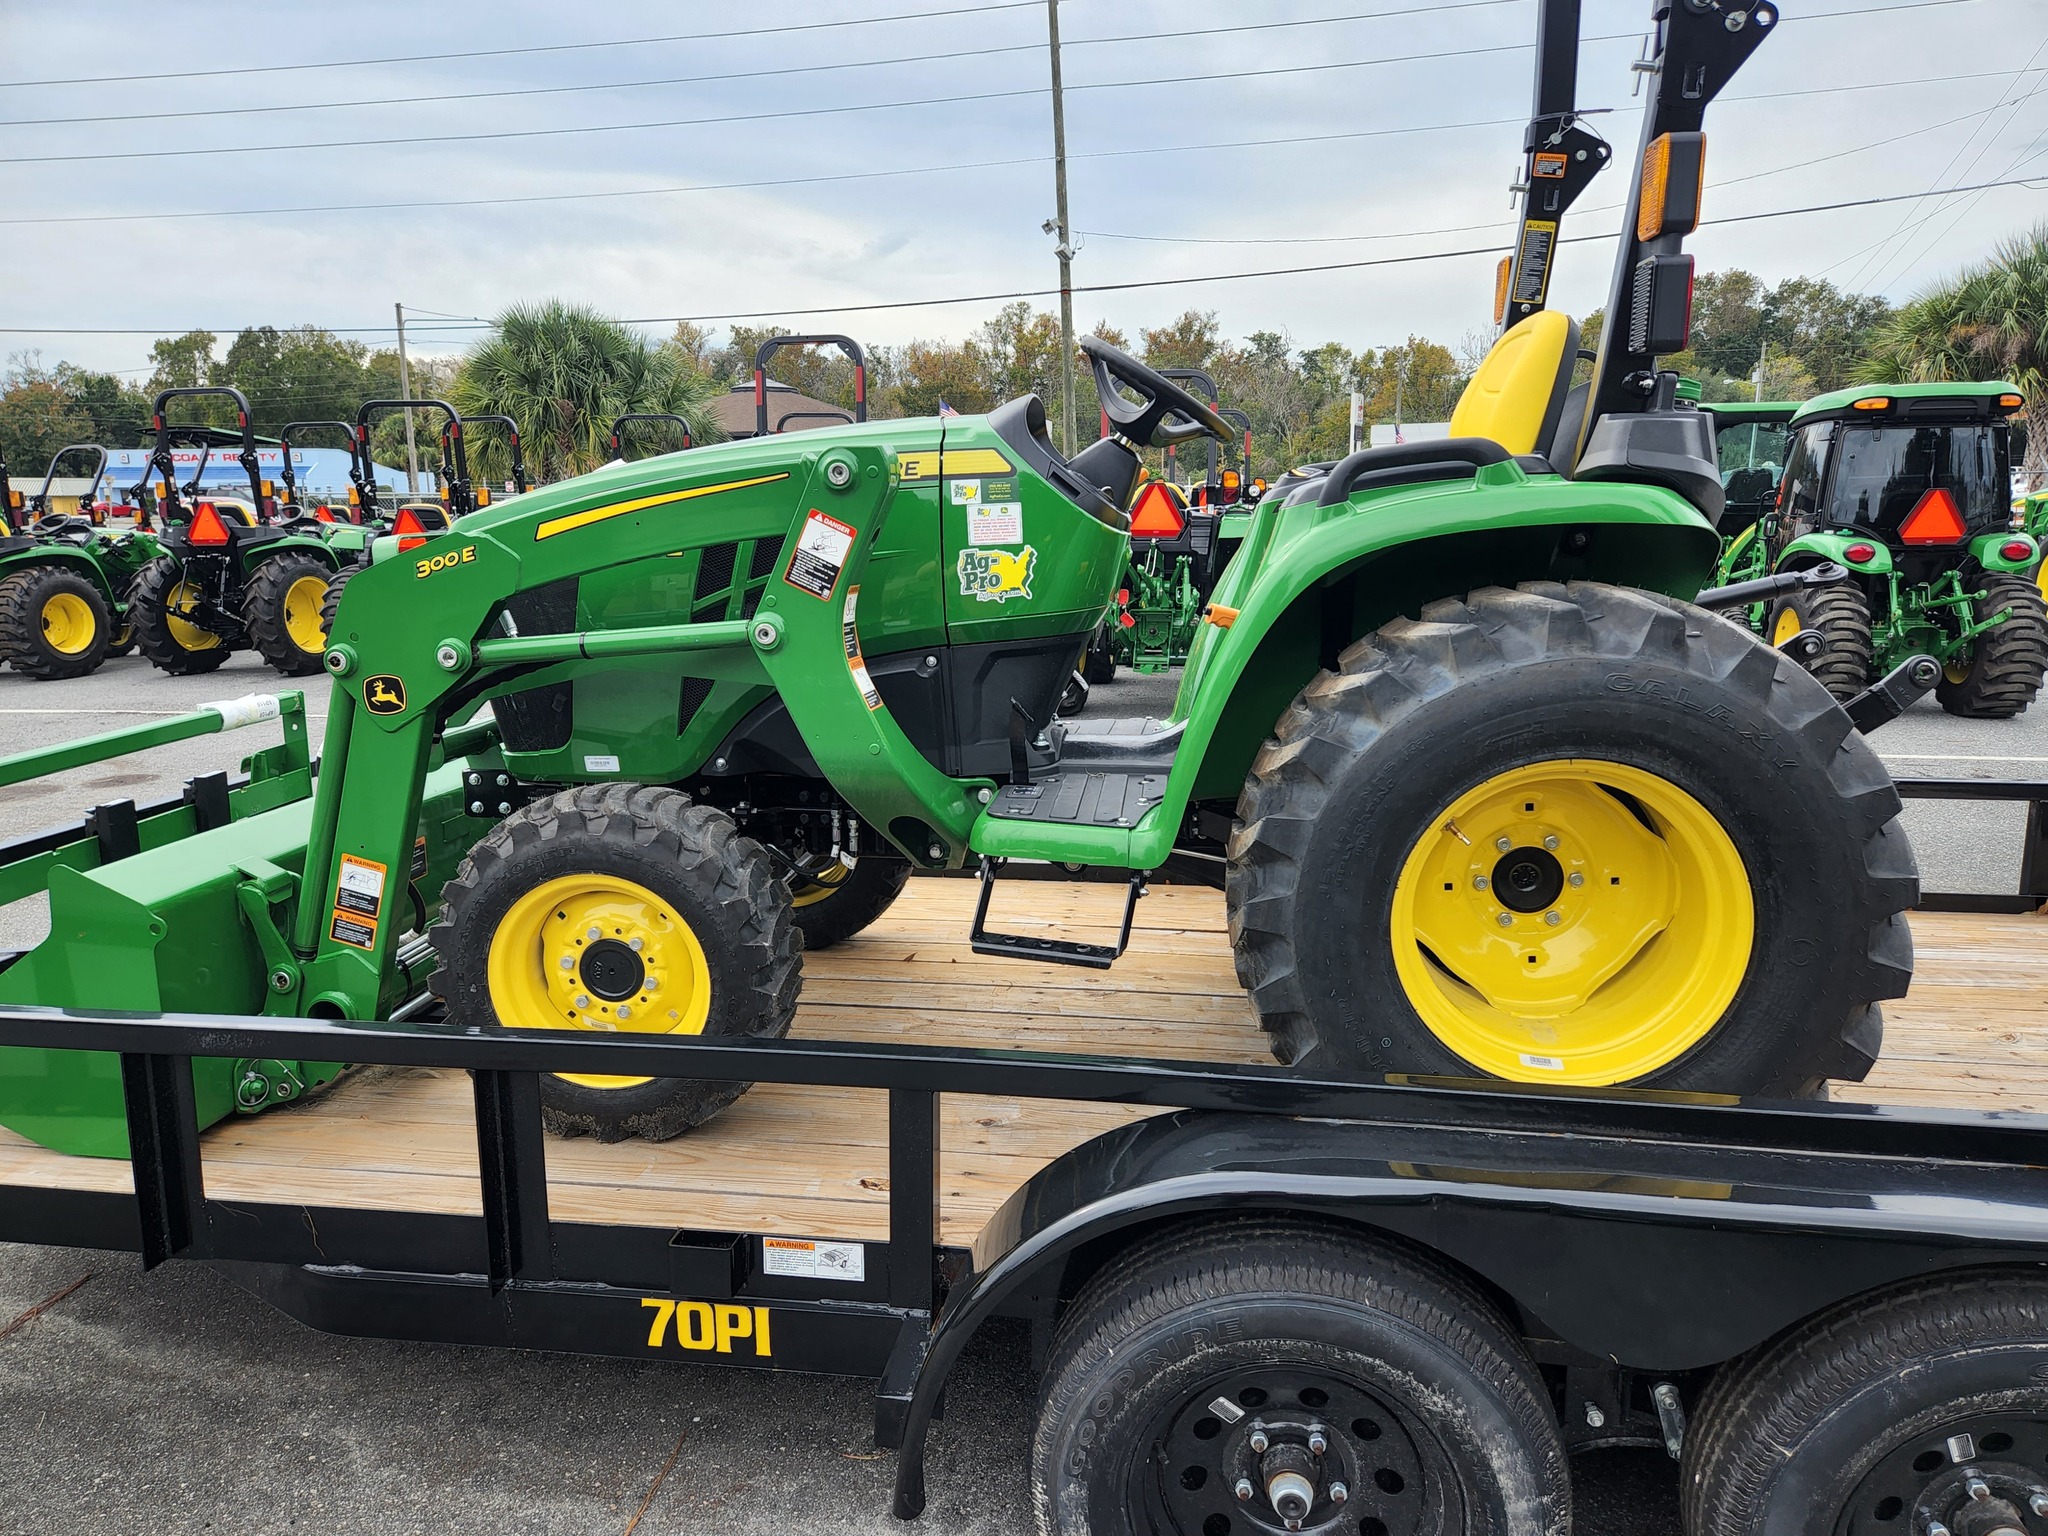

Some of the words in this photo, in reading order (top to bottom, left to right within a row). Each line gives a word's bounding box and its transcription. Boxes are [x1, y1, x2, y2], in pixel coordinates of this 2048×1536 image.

[823, 517, 851, 535] DANGER
[416, 551, 460, 578] 300
[462, 545, 476, 563] E
[962, 553, 998, 574] Ag-
[964, 572, 1001, 591] Pro
[1603, 672, 1800, 768] GALAXY
[354, 858, 381, 870] WARNING
[345, 914, 373, 927] WARNING
[776, 1241, 809, 1250] WARNING
[641, 1298, 773, 1357] 70PI
[1069, 1317, 1243, 1475] GOODRIDE
